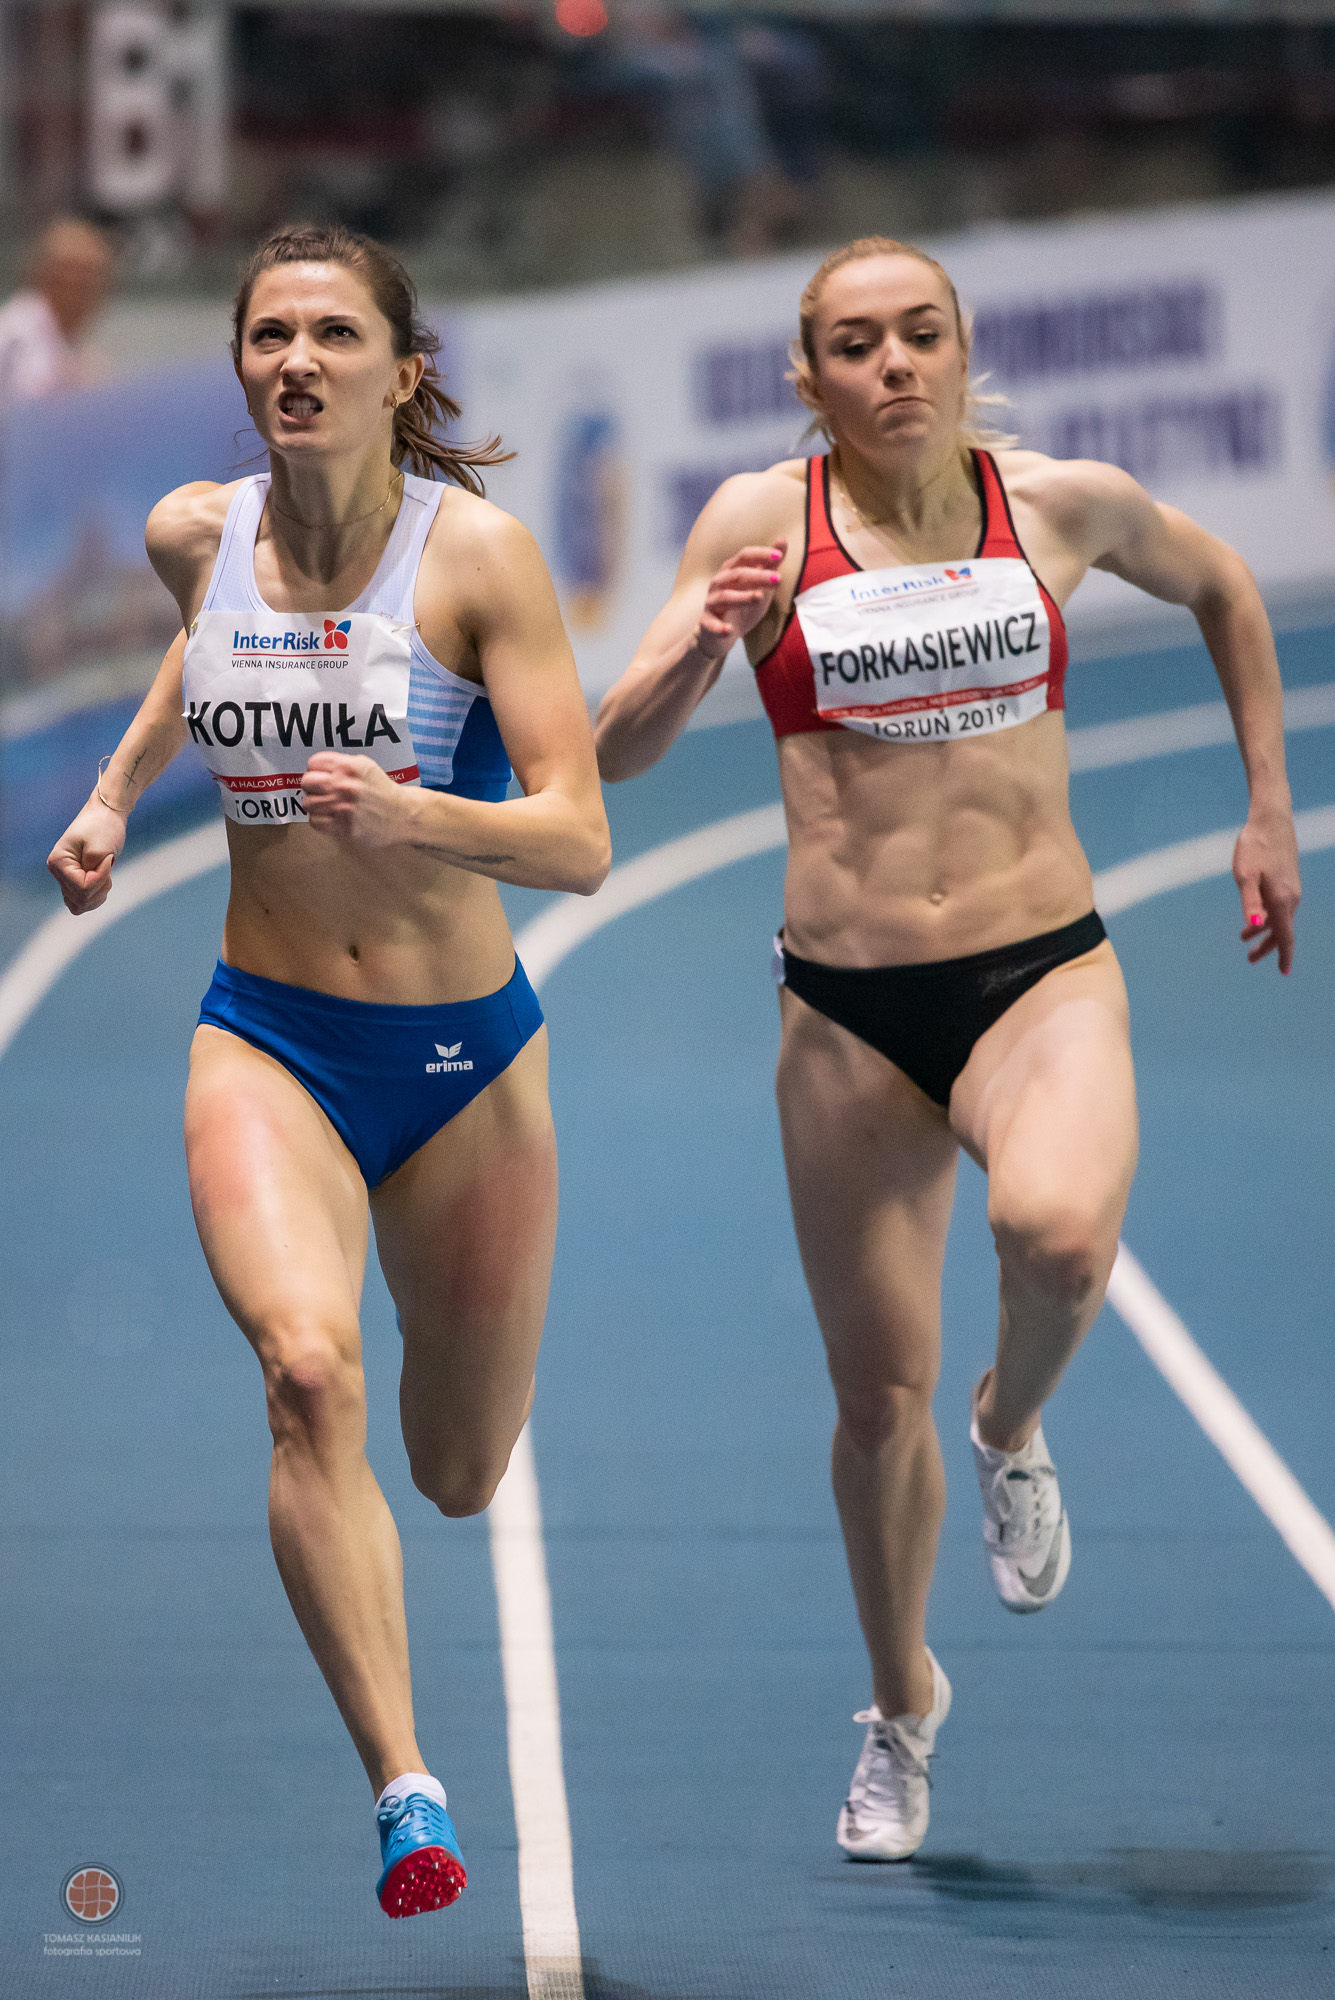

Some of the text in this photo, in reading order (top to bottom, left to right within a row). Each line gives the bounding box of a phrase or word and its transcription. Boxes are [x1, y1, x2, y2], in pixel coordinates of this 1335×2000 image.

[851, 575, 944, 601] InterRisk
[233, 630, 321, 650] InterRisk
[819, 612, 1041, 686] FORKASIEWICZ
[231, 660, 349, 670] VIENNA INSURANCE GROUP
[187, 700, 402, 748] KOTWIŁA
[957, 704, 1007, 731] 2019
[240, 777, 284, 789] HALOWE
[426, 1060, 473, 1073] erima
